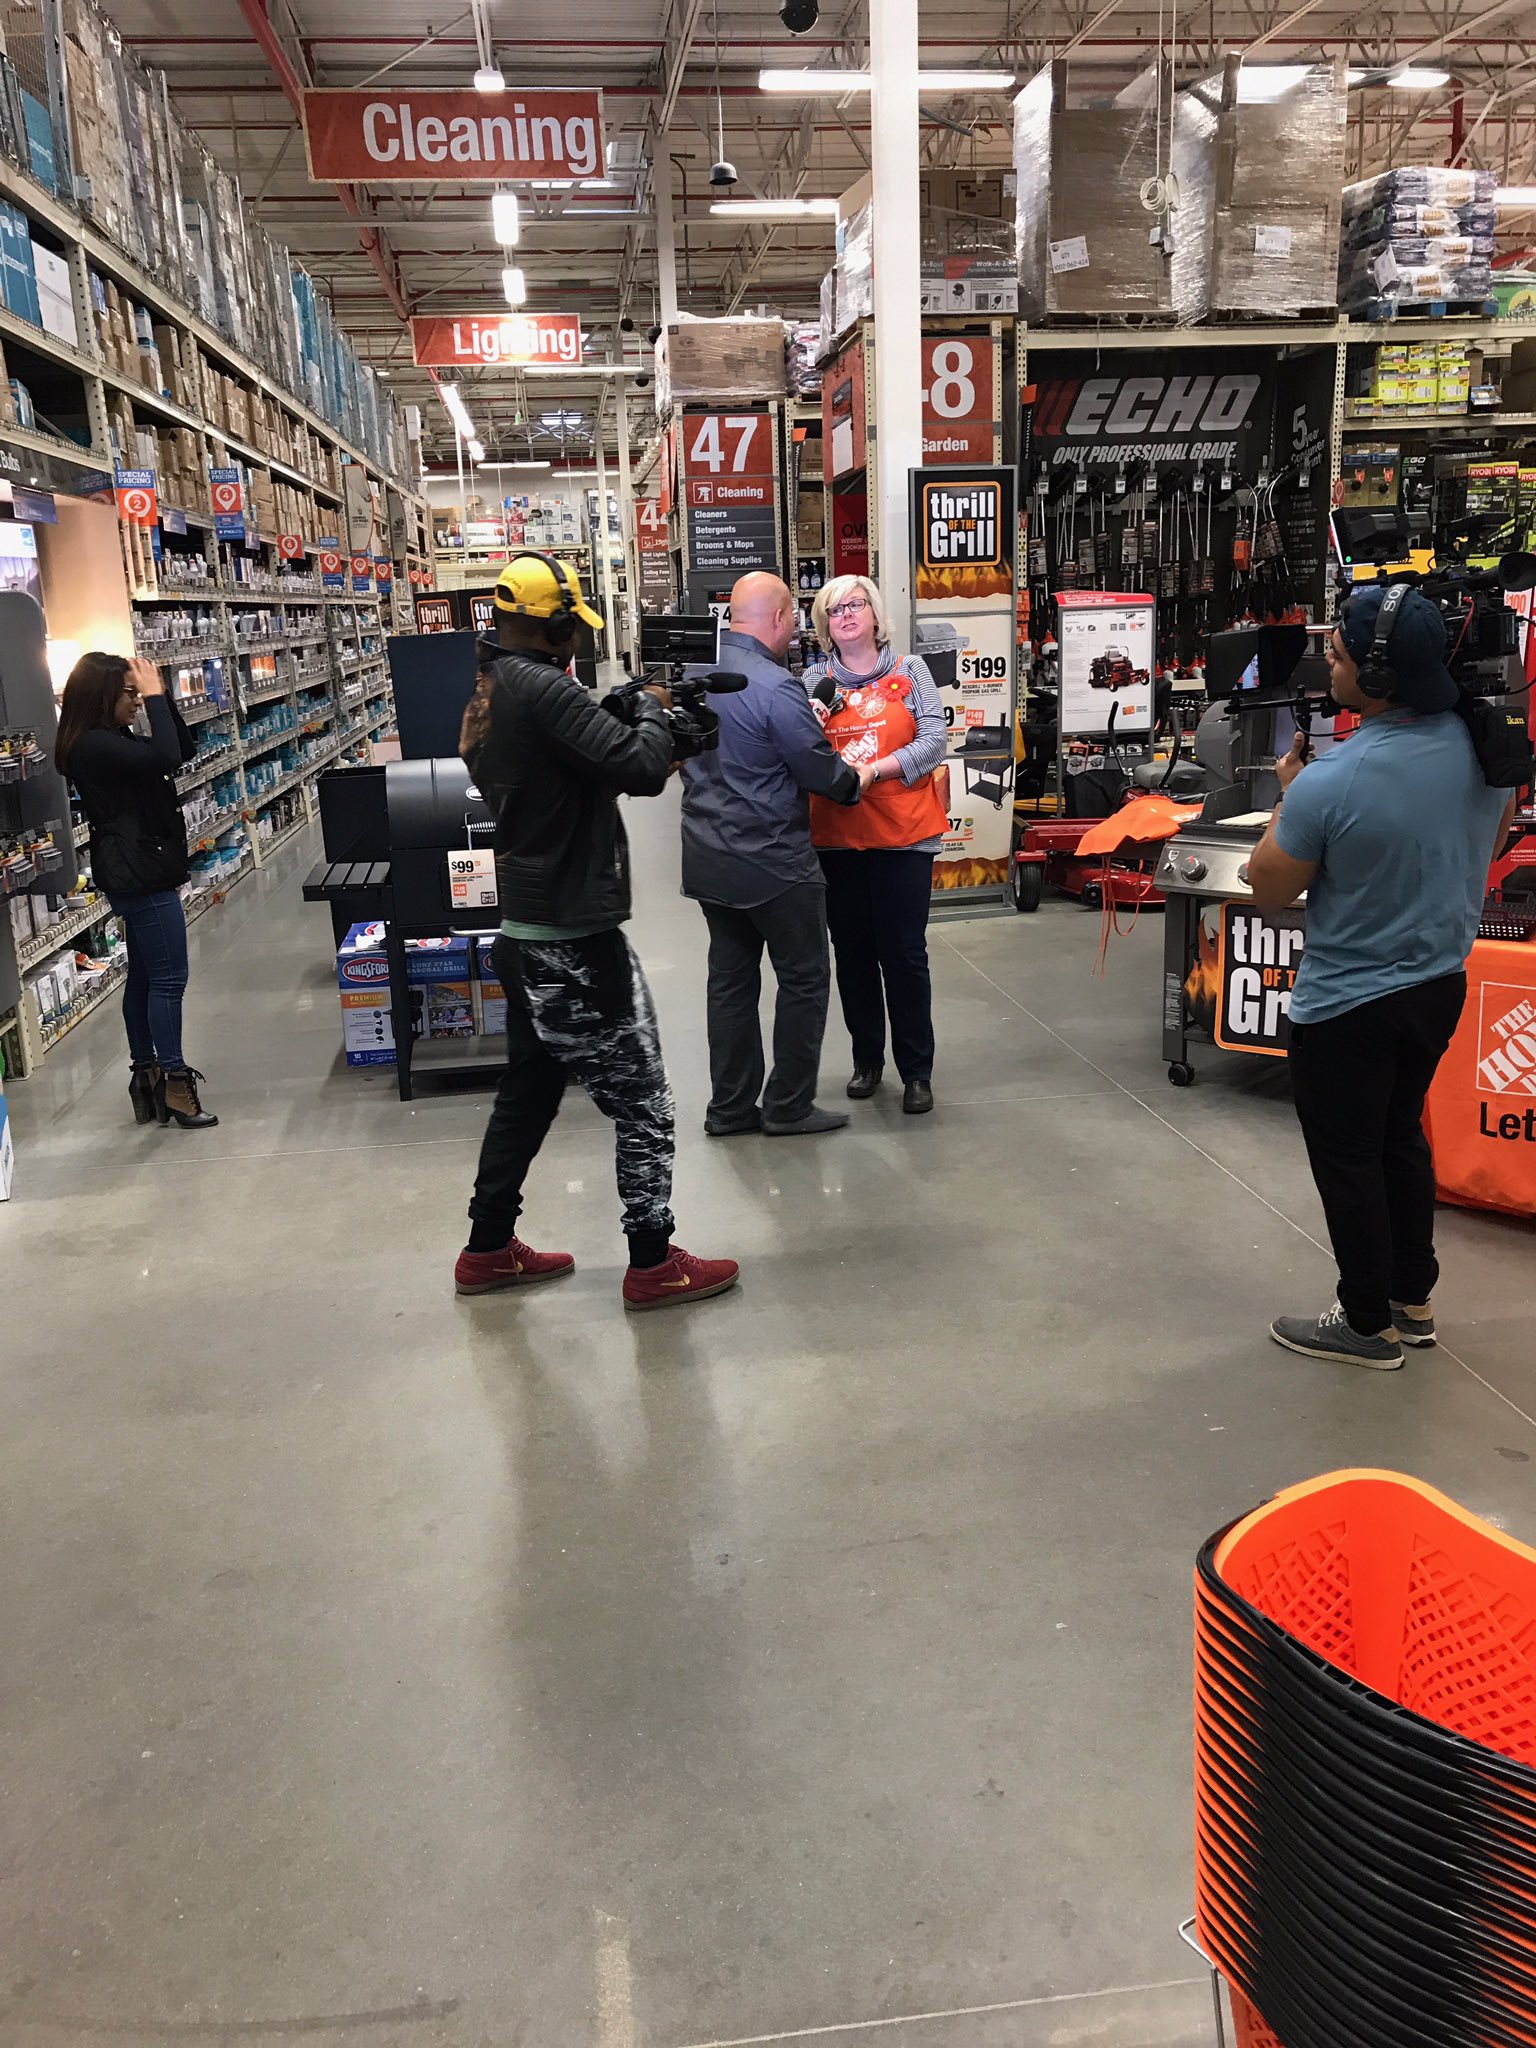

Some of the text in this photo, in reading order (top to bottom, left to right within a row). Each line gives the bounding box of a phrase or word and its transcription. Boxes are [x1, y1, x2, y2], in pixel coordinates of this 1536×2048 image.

[362, 102, 597, 174] Cleaning
[453, 321, 577, 361] Liging
[922, 341, 976, 418] 8
[1066, 374, 1261, 435] ECHO
[1293, 403, 1308, 450] 5
[691, 417, 758, 473] 47
[922, 437, 969, 453] Garden
[1052, 446, 1089, 465] ONLY
[1088, 443, 1187, 463] PROFESSIONAL
[1471, 468, 1491, 476] RYOBI
[1494, 466, 1516, 475] RYOBI
[717, 486, 764, 499] Cleaning
[133, 499, 142, 509] 2
[930, 492, 994, 520] thrill
[695, 510, 728, 519] Cleaners
[696, 526, 737, 535] Detergents
[949, 520, 977, 531] OF THE
[696, 540, 754, 549] Brooms & Mops
[930, 520, 994, 558] Grill
[697, 556, 762, 566] Cleaning Supplies
[420, 605, 449, 624] thrill
[474, 602, 495, 620] thr
[962, 657, 1006, 679] $199
[869, 719, 887, 728] Depot
[451, 860, 474, 873] $99
[1232, 916, 1304, 967] thr
[1263, 968, 1281, 987] OF
[1489, 999, 1536, 1040] THE
